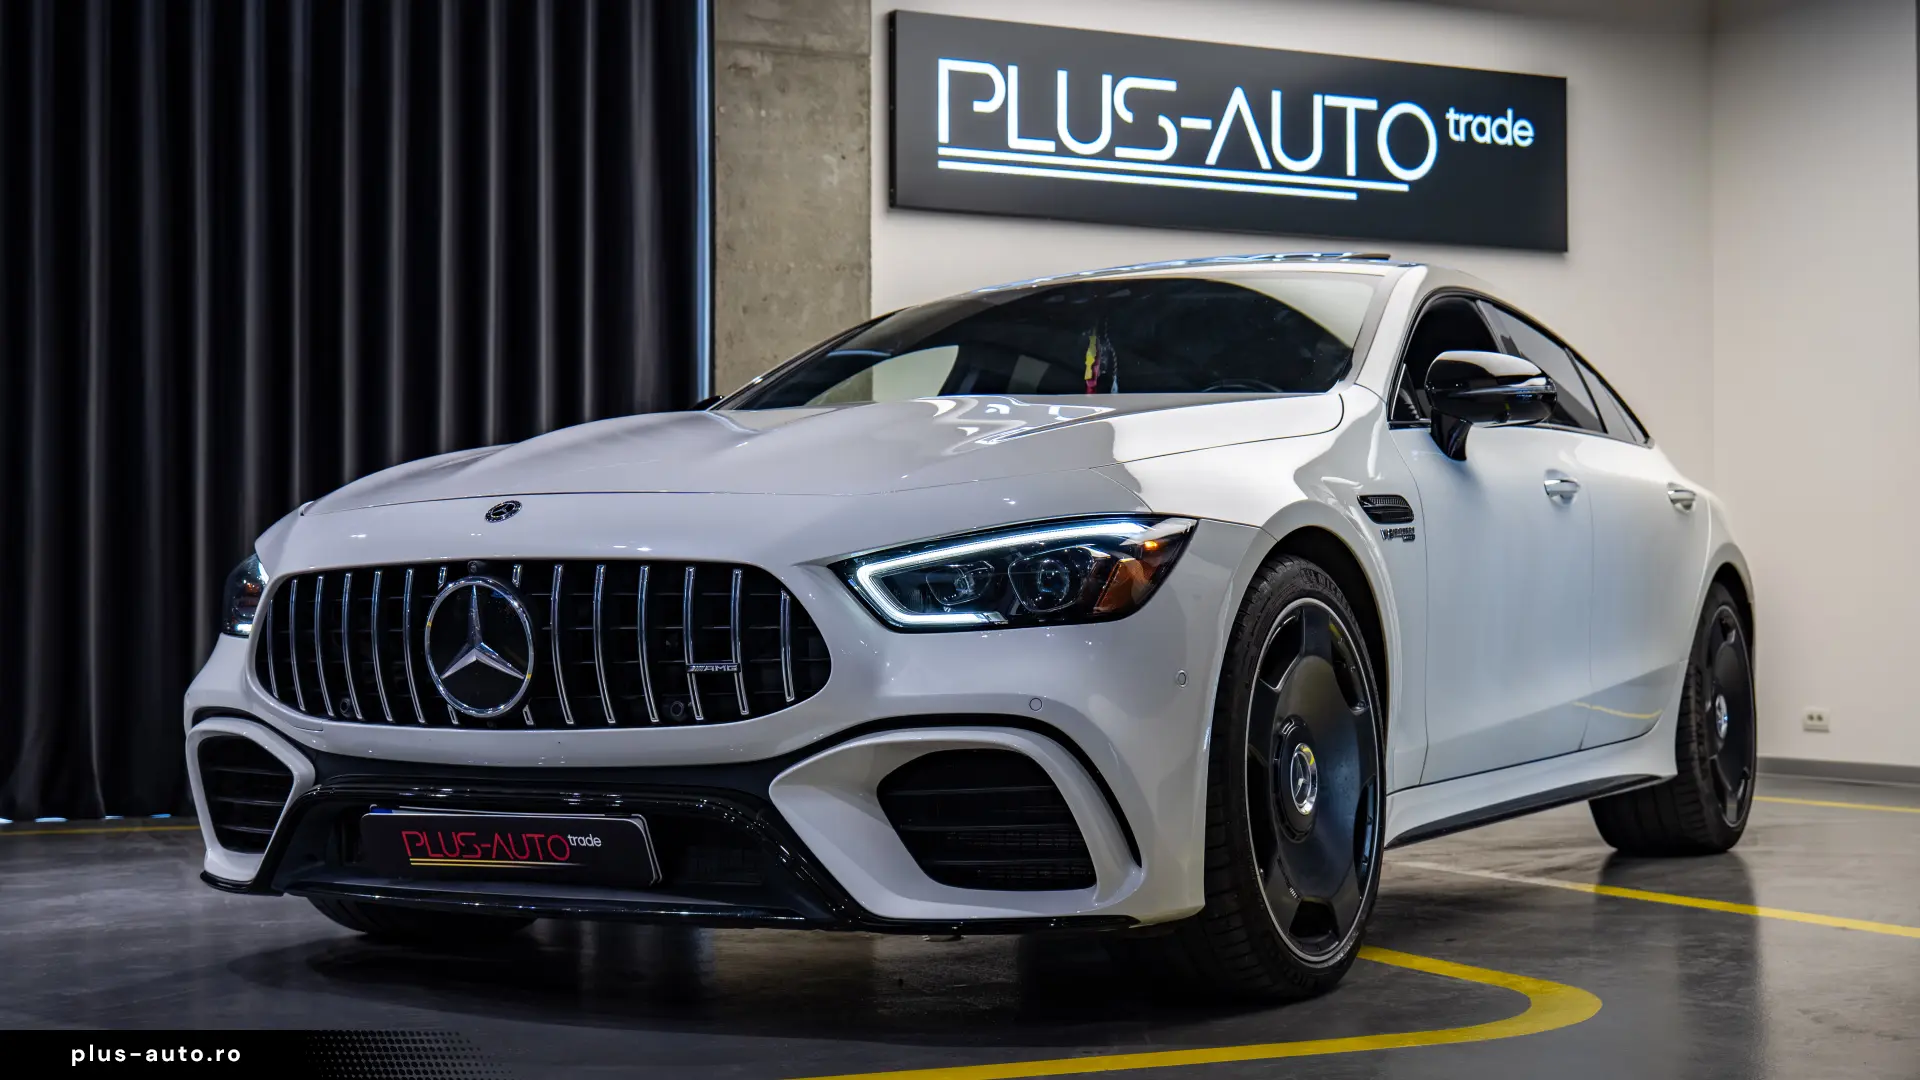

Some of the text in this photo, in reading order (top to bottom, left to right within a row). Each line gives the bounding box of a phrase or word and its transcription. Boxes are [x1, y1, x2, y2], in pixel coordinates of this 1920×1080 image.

[938, 58, 1534, 181] PLUS-AUTO trade
[703, 664, 738, 672] AMG
[401, 830, 602, 861] PLUS-AUTO trade
